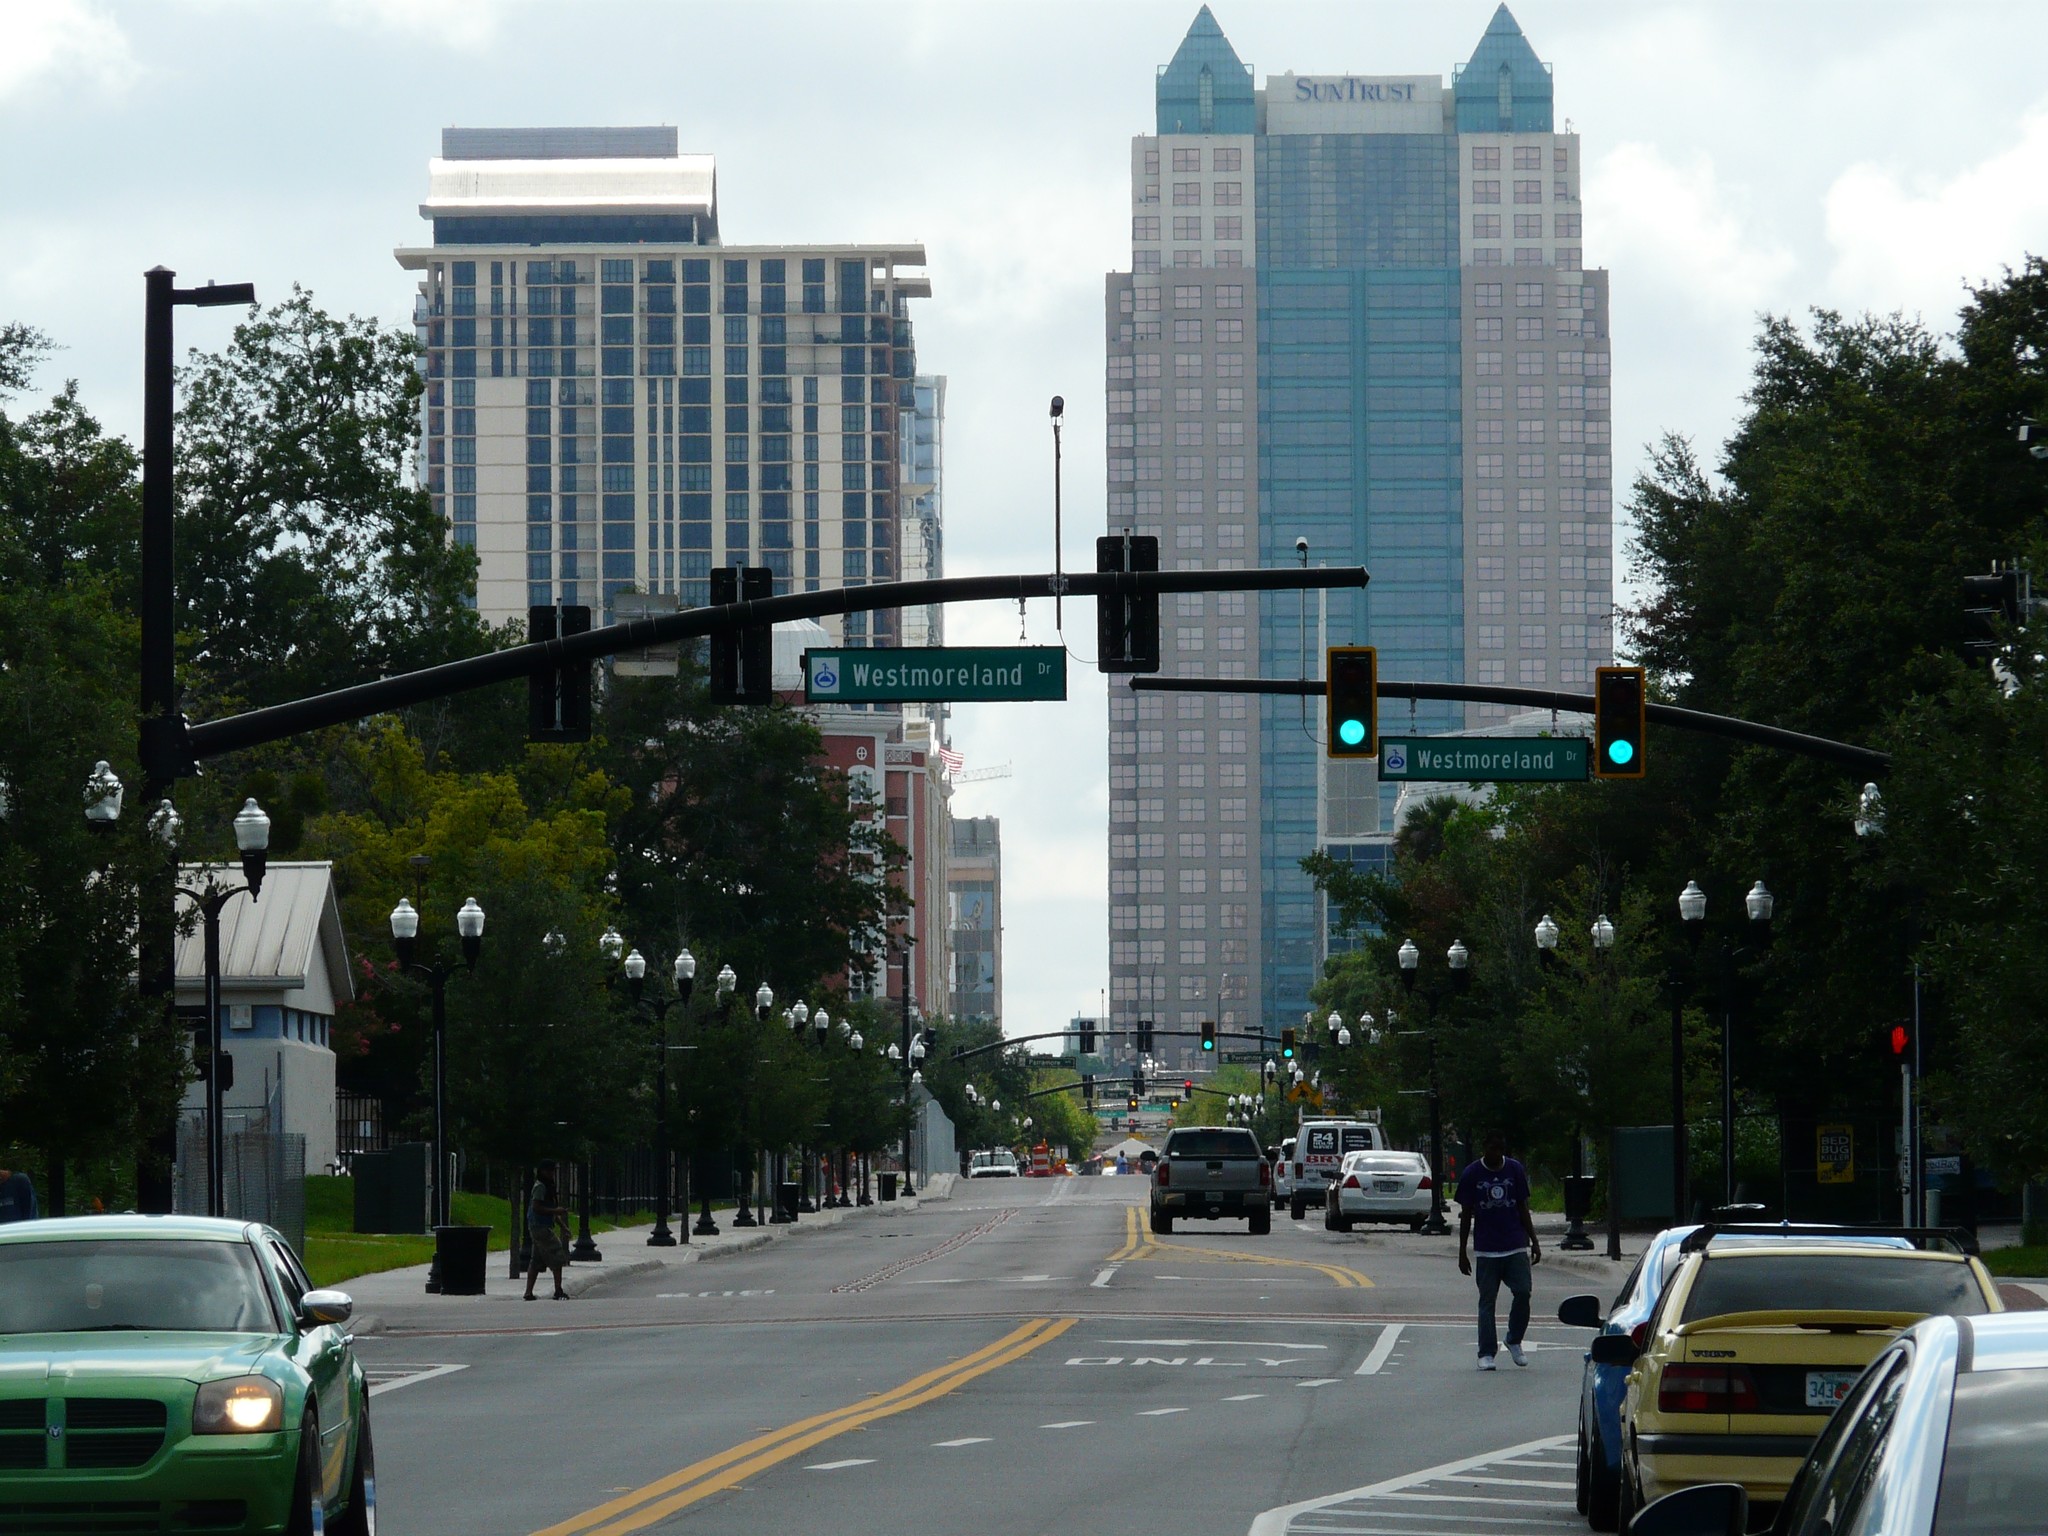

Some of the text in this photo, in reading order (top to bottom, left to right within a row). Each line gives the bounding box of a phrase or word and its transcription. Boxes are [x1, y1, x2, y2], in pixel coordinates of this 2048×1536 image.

[852, 662, 1051, 687] Westmoreland Dr
[1417, 750, 1577, 769] Westmoreland Dr
[1313, 1132, 1334, 1142] 24
[1821, 1136, 1849, 1145] BED
[1821, 1145, 1850, 1154] BUG
[1821, 1154, 1850, 1162] KILLER
[1065, 1356, 1307, 1366] ONLY
[1809, 1380, 1834, 1399] 343
